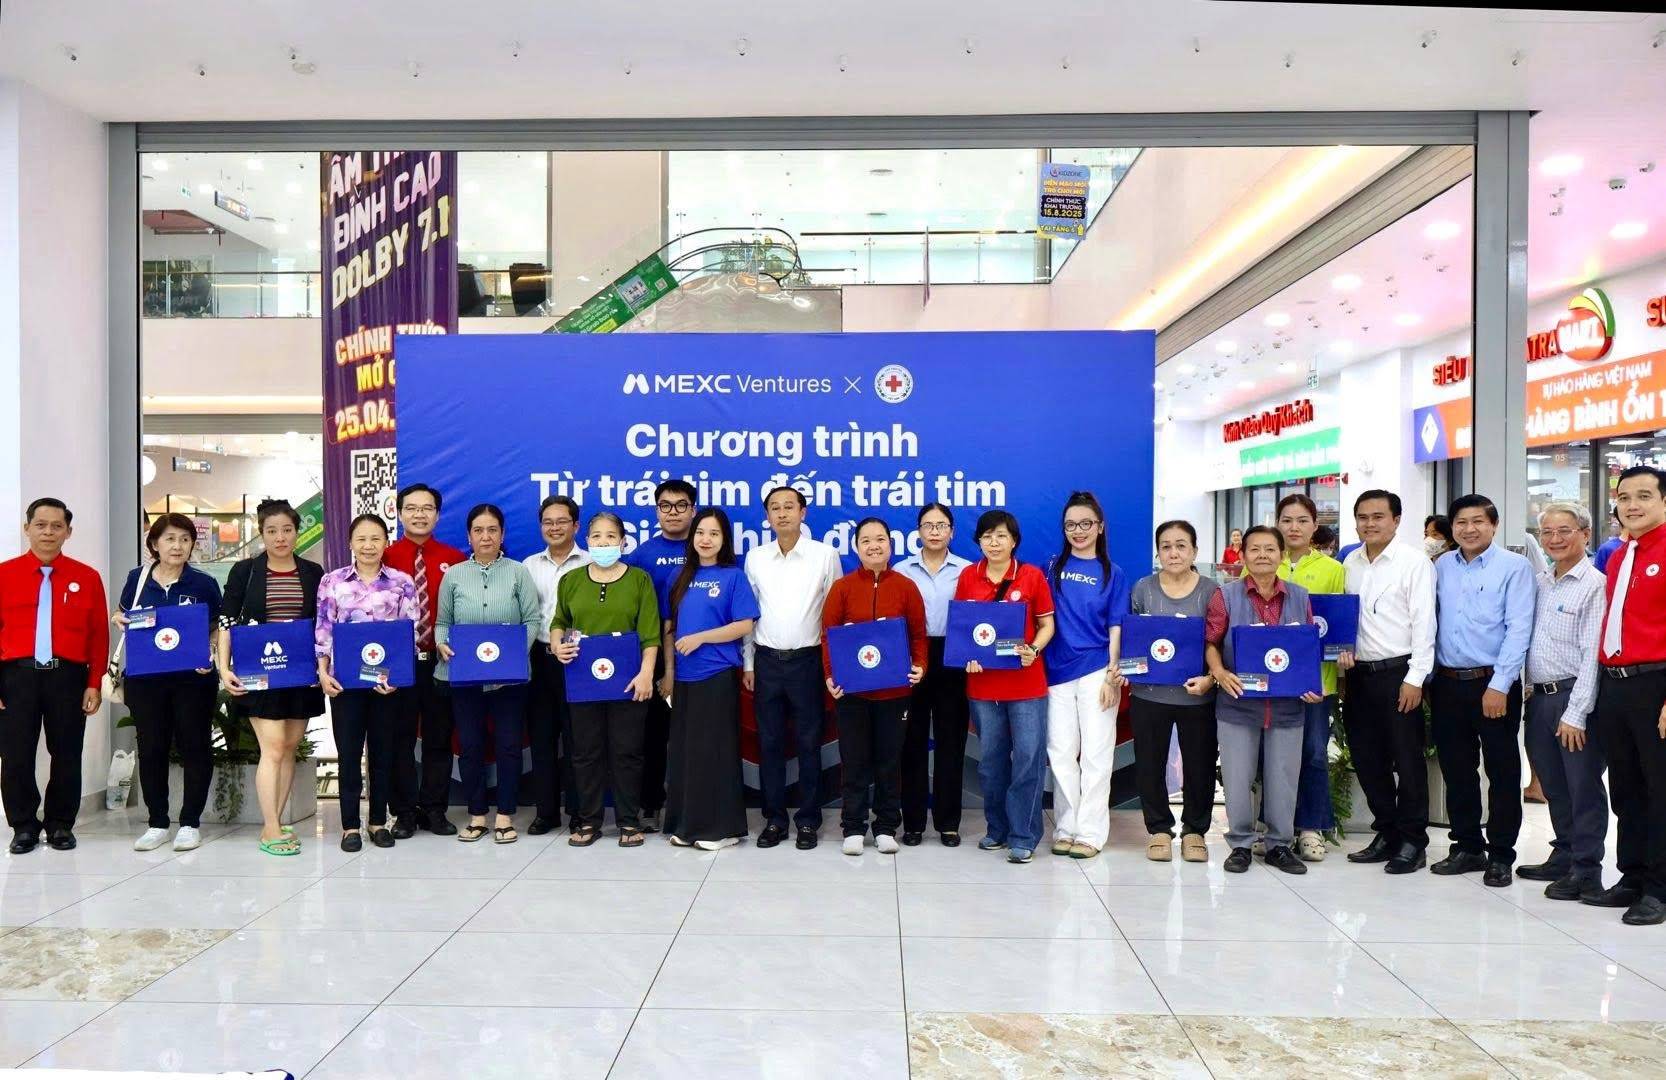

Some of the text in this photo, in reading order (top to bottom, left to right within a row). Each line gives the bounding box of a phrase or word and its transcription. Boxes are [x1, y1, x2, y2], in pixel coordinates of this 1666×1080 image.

[330, 152, 362, 205] ÂM
[394, 152, 442, 213] CAO
[1043, 209, 1083, 218] 15.8.2025
[332, 194, 449, 310] DOLBY 7.1
[335, 325, 392, 366] CHÍNH
[356, 353, 384, 393] MỞ
[655, 374, 731, 393] MEXC
[737, 374, 832, 393] Ventures
[1626, 361, 1652, 382] NAM
[335, 398, 395, 442] 25.04.
[625, 421, 919, 466] Chương trình
[530, 470, 591, 506] Từ
[852, 470, 925, 506] trái
[934, 470, 1006, 506] tim
[668, 557, 687, 565] ME
[1066, 572, 1098, 586] MEXC
[260, 655, 289, 665] MEXC
